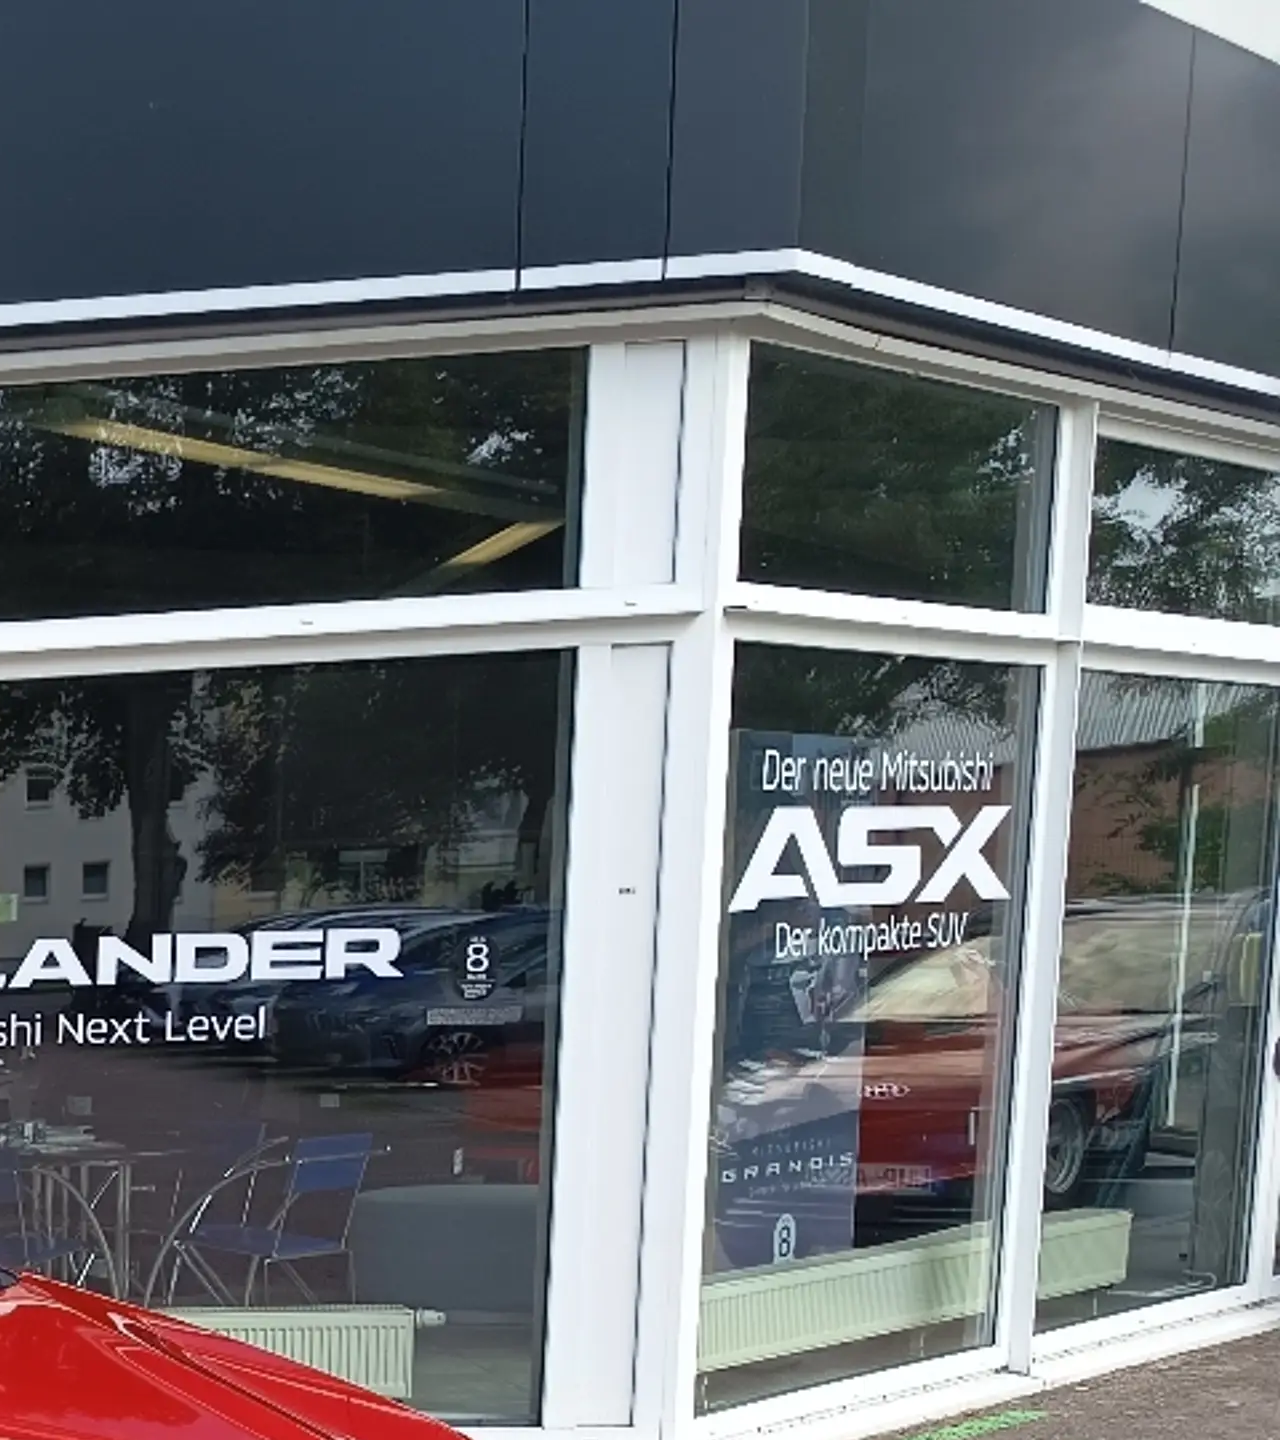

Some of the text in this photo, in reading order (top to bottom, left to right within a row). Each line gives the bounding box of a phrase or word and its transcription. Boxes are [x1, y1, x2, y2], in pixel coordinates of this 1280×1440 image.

[762, 749, 995, 793] Der neue Mitsubishi
[729, 804, 1013, 913] ASX
[775, 911, 969, 959] Der kompakte SUV
[466, 943, 489, 972] 8
[56, 1007, 151, 1046] Next
[164, 1003, 268, 1045] Level
